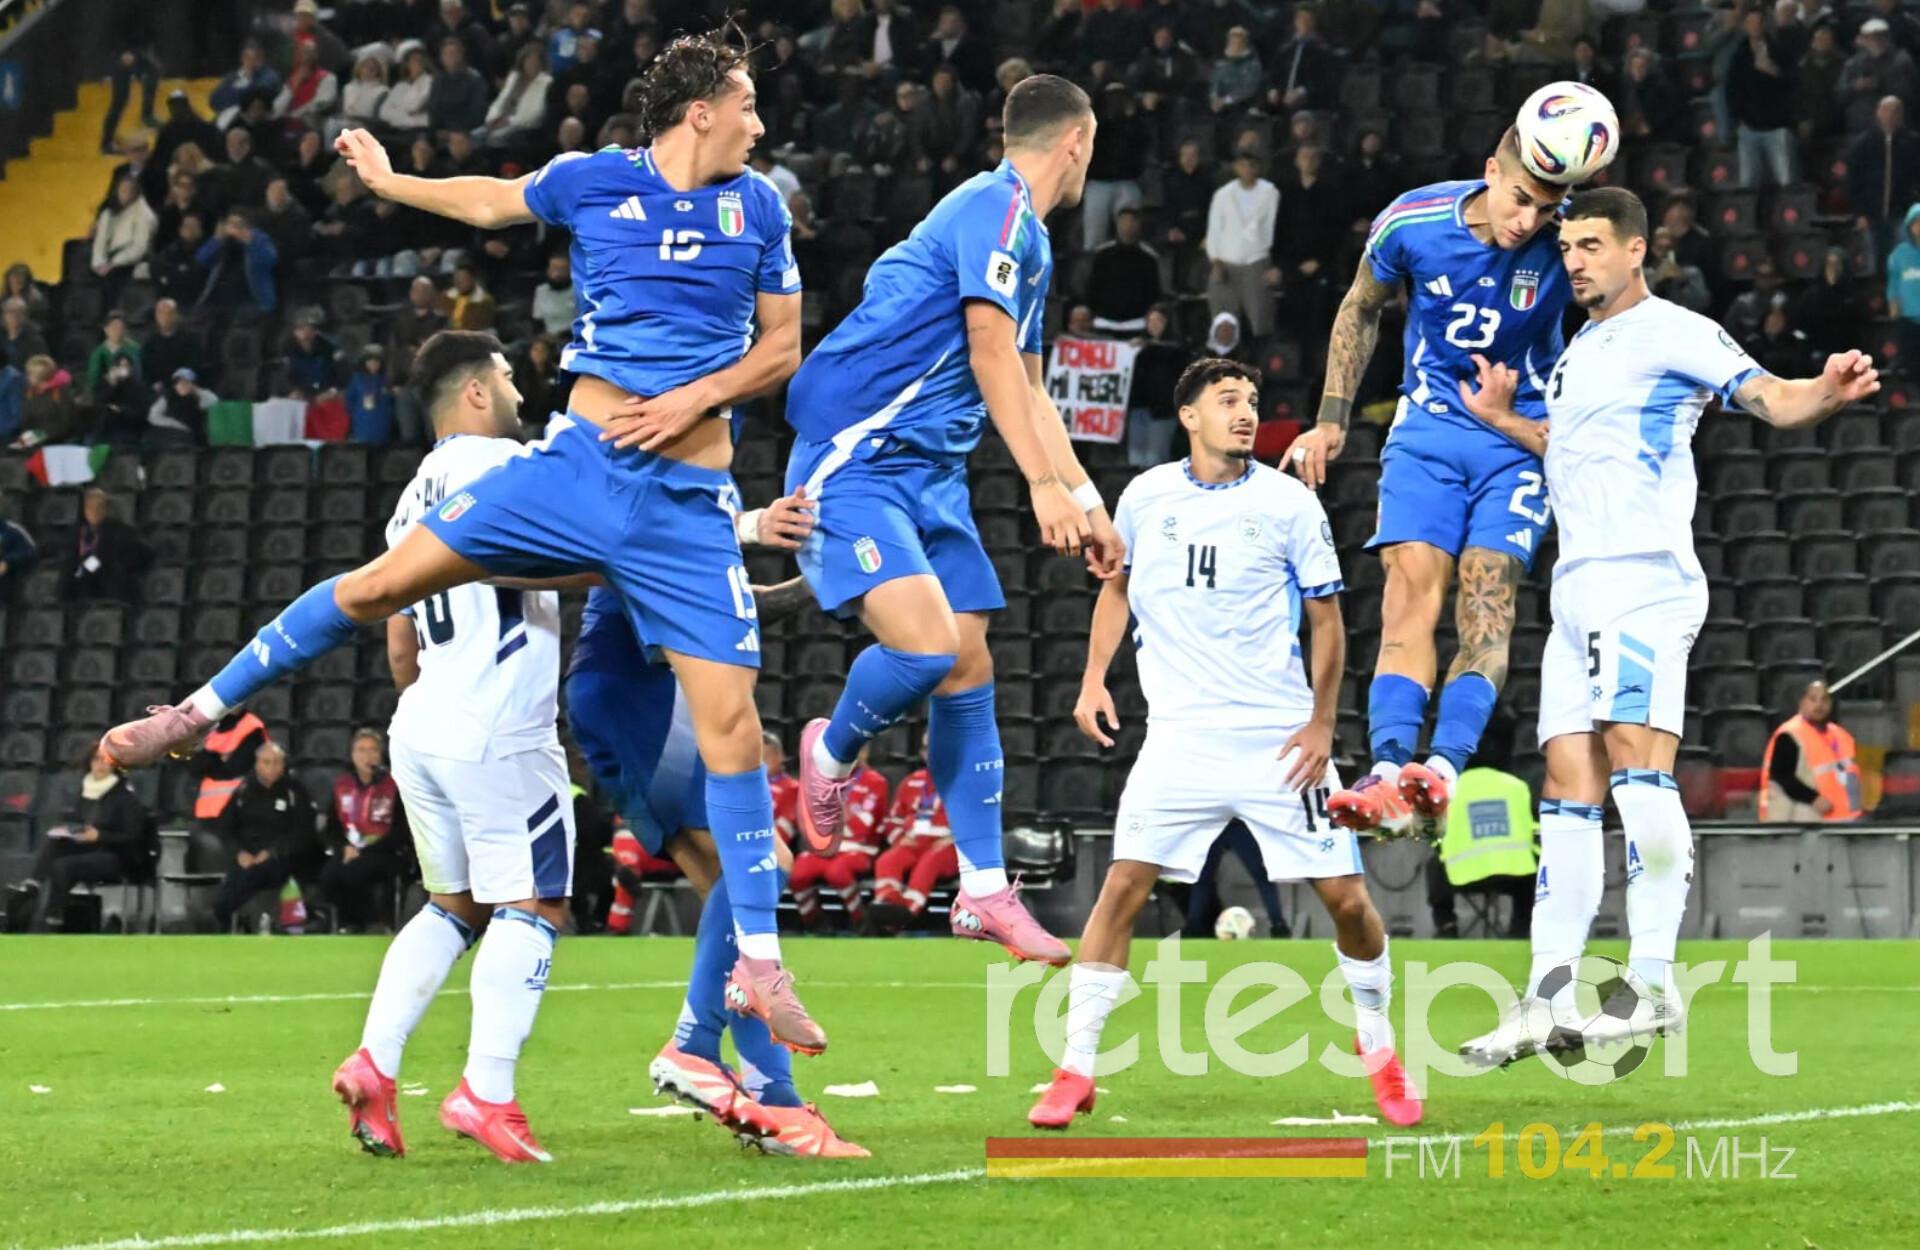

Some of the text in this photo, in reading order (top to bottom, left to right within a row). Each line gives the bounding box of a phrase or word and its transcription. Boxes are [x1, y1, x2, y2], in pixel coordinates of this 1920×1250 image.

[659, 229, 706, 261] 15
[1445, 303, 1502, 349] 23
[1186, 544, 1216, 589] 14
[727, 565, 757, 619] 15
[1588, 631, 1601, 678] 5
